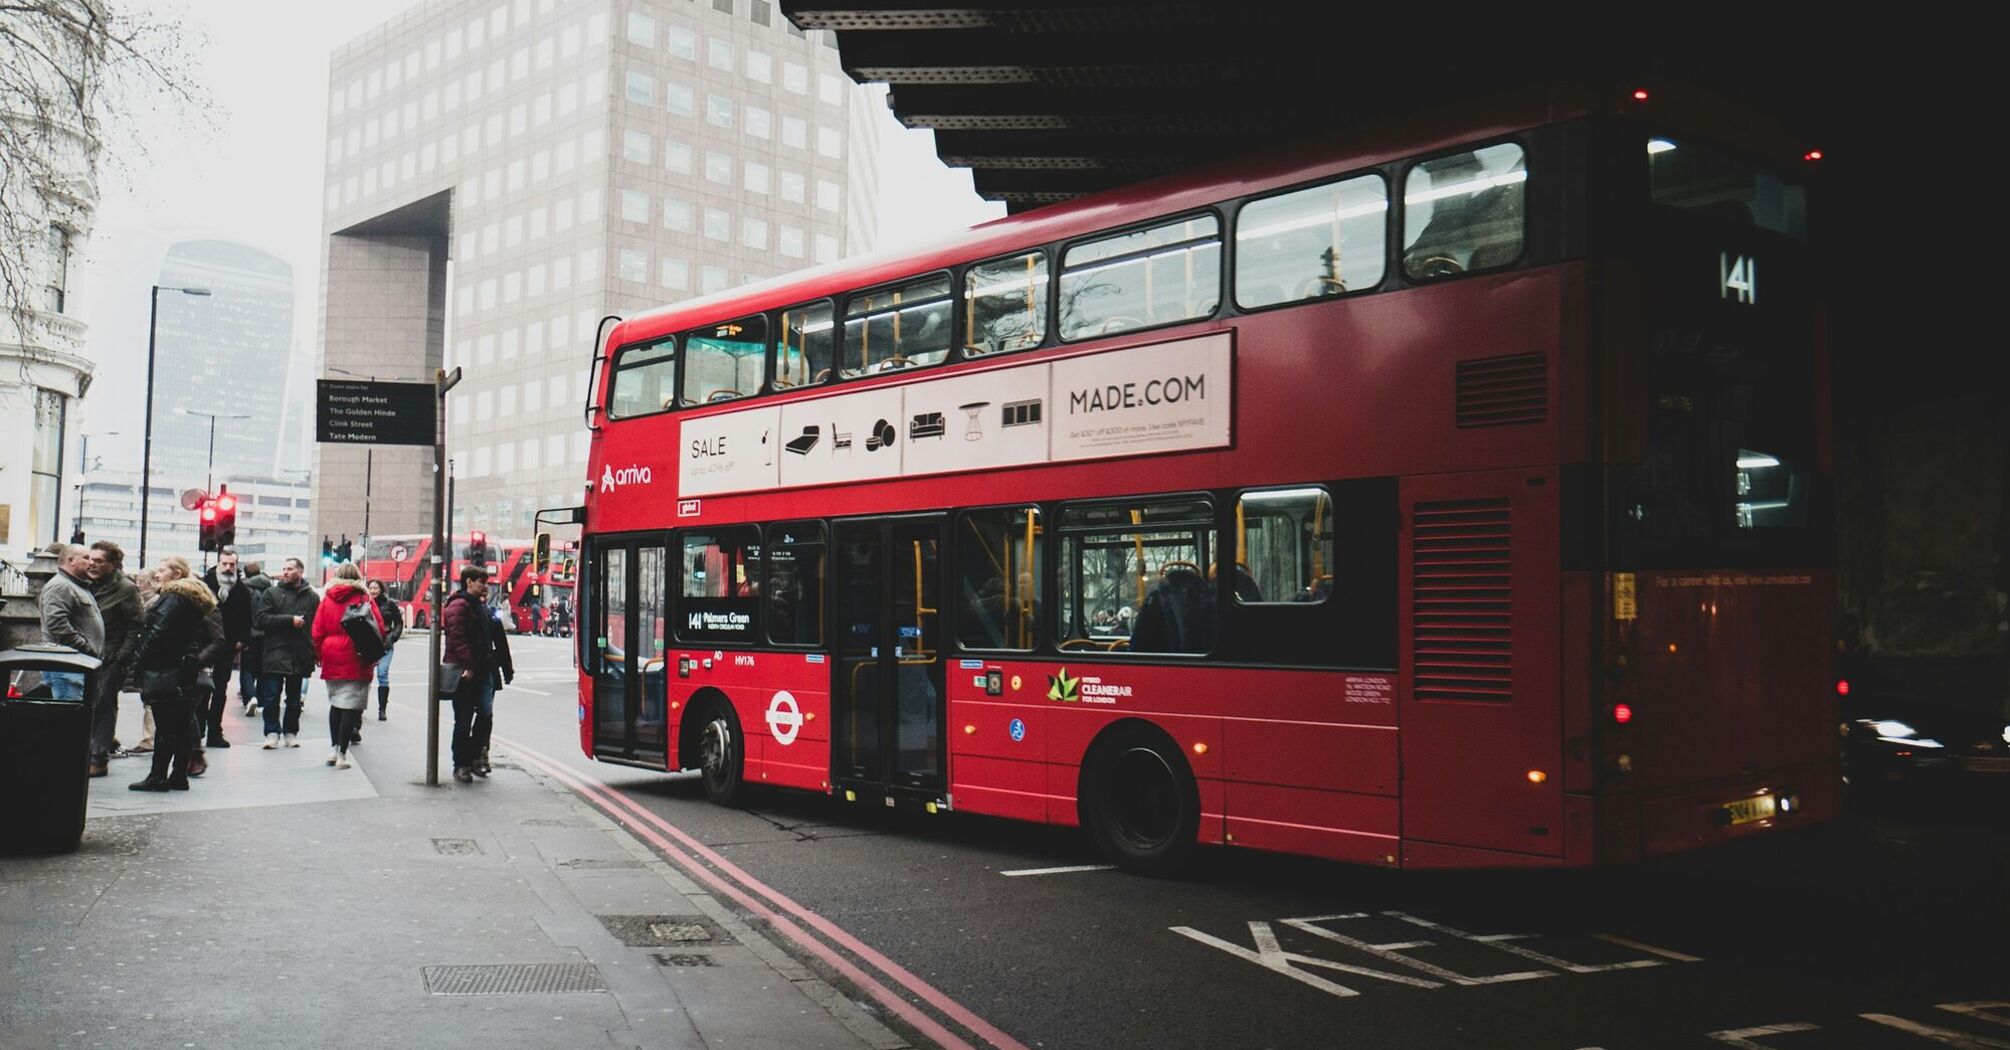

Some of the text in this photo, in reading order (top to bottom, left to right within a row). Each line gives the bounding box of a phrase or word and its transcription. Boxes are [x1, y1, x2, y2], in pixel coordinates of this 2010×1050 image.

[1719, 251, 1756, 305] 141
[329, 395, 388, 404] Borough Market
[1070, 374, 1205, 415] MADE.COM
[345, 408, 373, 416] Golden
[329, 420, 348, 428] Clink
[347, 433, 377, 441] Modern
[691, 436, 726, 459] SALE
[615, 463, 651, 485] arriva
[689, 612, 750, 630] 141 Palmers Green
[714, 651, 723, 661] AD
[735, 655, 755, 667] HV176
